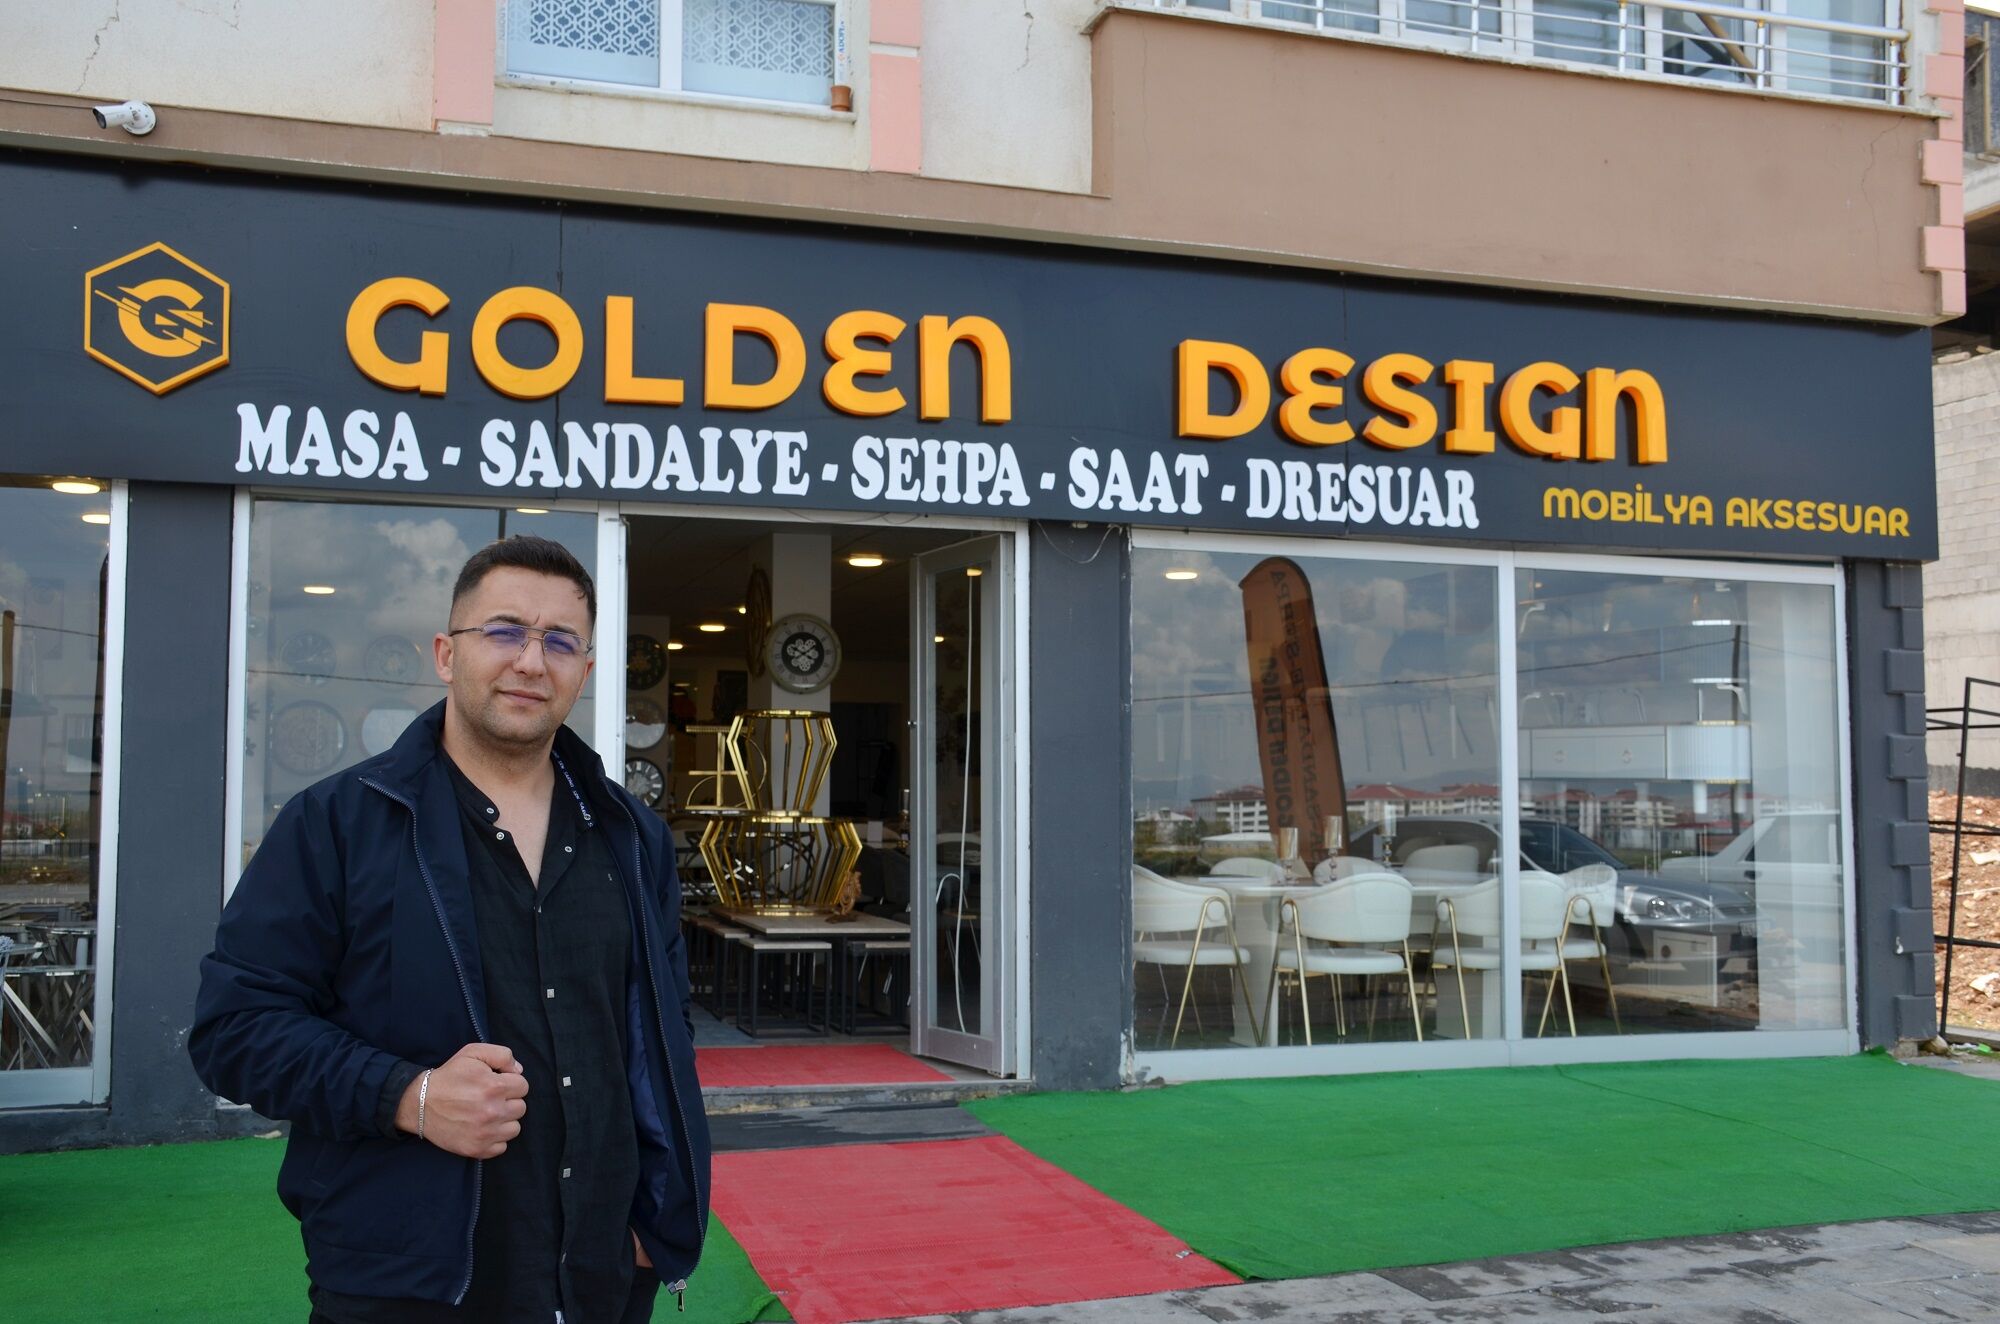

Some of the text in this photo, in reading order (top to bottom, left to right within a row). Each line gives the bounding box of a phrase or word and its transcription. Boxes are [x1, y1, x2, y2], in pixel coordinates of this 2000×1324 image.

[345, 276, 1669, 465] GOLDEN DESIGN
[234, 402, 429, 482] MASA
[479, 418, 810, 497] SANDALYE
[850, 435, 1031, 507] SEHPA
[1068, 446, 1210, 515] SAAT
[1245, 458, 1480, 530] DRESUAR
[1724, 497, 1911, 538] AKSESUAR
